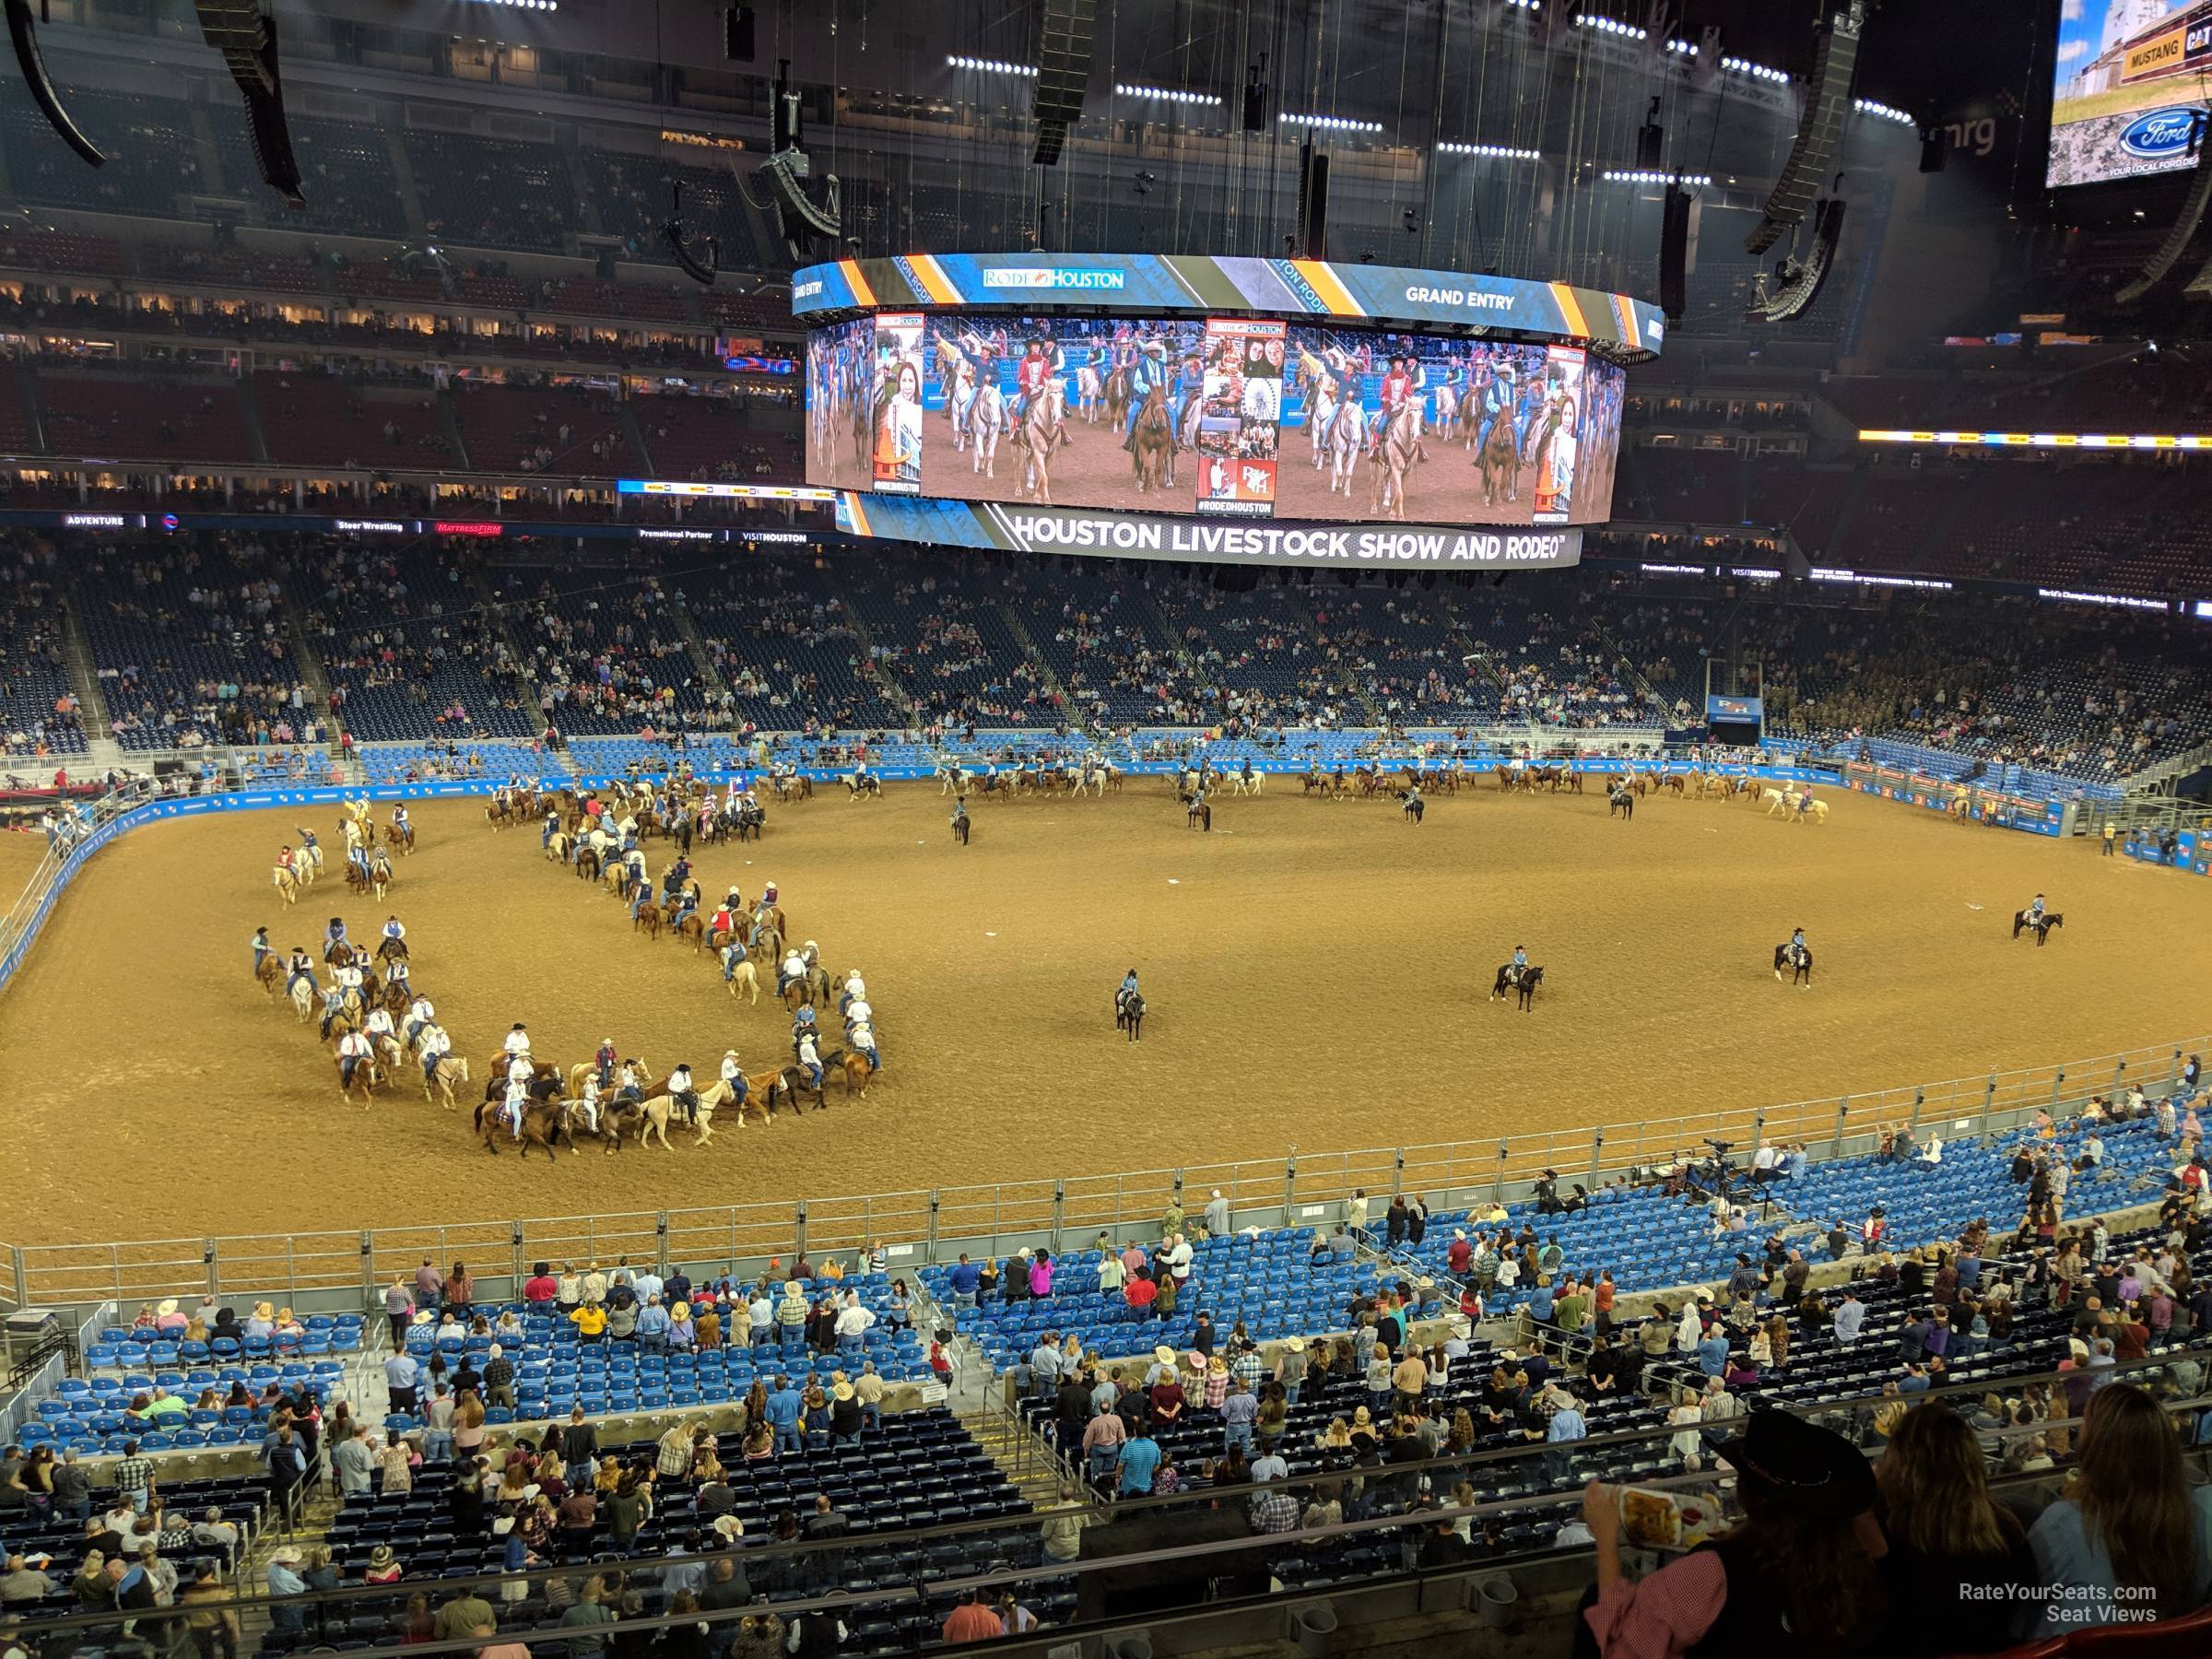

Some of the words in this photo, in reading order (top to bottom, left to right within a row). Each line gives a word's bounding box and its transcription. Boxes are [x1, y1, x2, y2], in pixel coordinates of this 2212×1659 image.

[2131, 40, 2180, 69] MUSTANG
[2186, 26, 2211, 52] CAT
[2140, 117, 2193, 147] Ford
[2109, 167, 2132, 176] YOUR
[2132, 162, 2158, 173] LOCAL
[2159, 159, 2182, 170] FORD
[1406, 287, 1465, 305] GRAND
[1467, 291, 1515, 310] ENTRY
[1198, 500, 1272, 513] #RODEOHOUSTON
[640, 530, 684, 538] Promotional
[743, 532, 806, 543] VISITHOUSTON
[1015, 515, 1161, 550] HOUSTON
[1171, 525, 1349, 558] LIVESTOCK
[1357, 533, 1446, 560] SHOW
[1450, 535, 1501, 560] AND
[1641, 563, 1680, 572] Promotional
[1680, 565, 1705, 573] Partner
[2062, 591, 2106, 603] Championship
